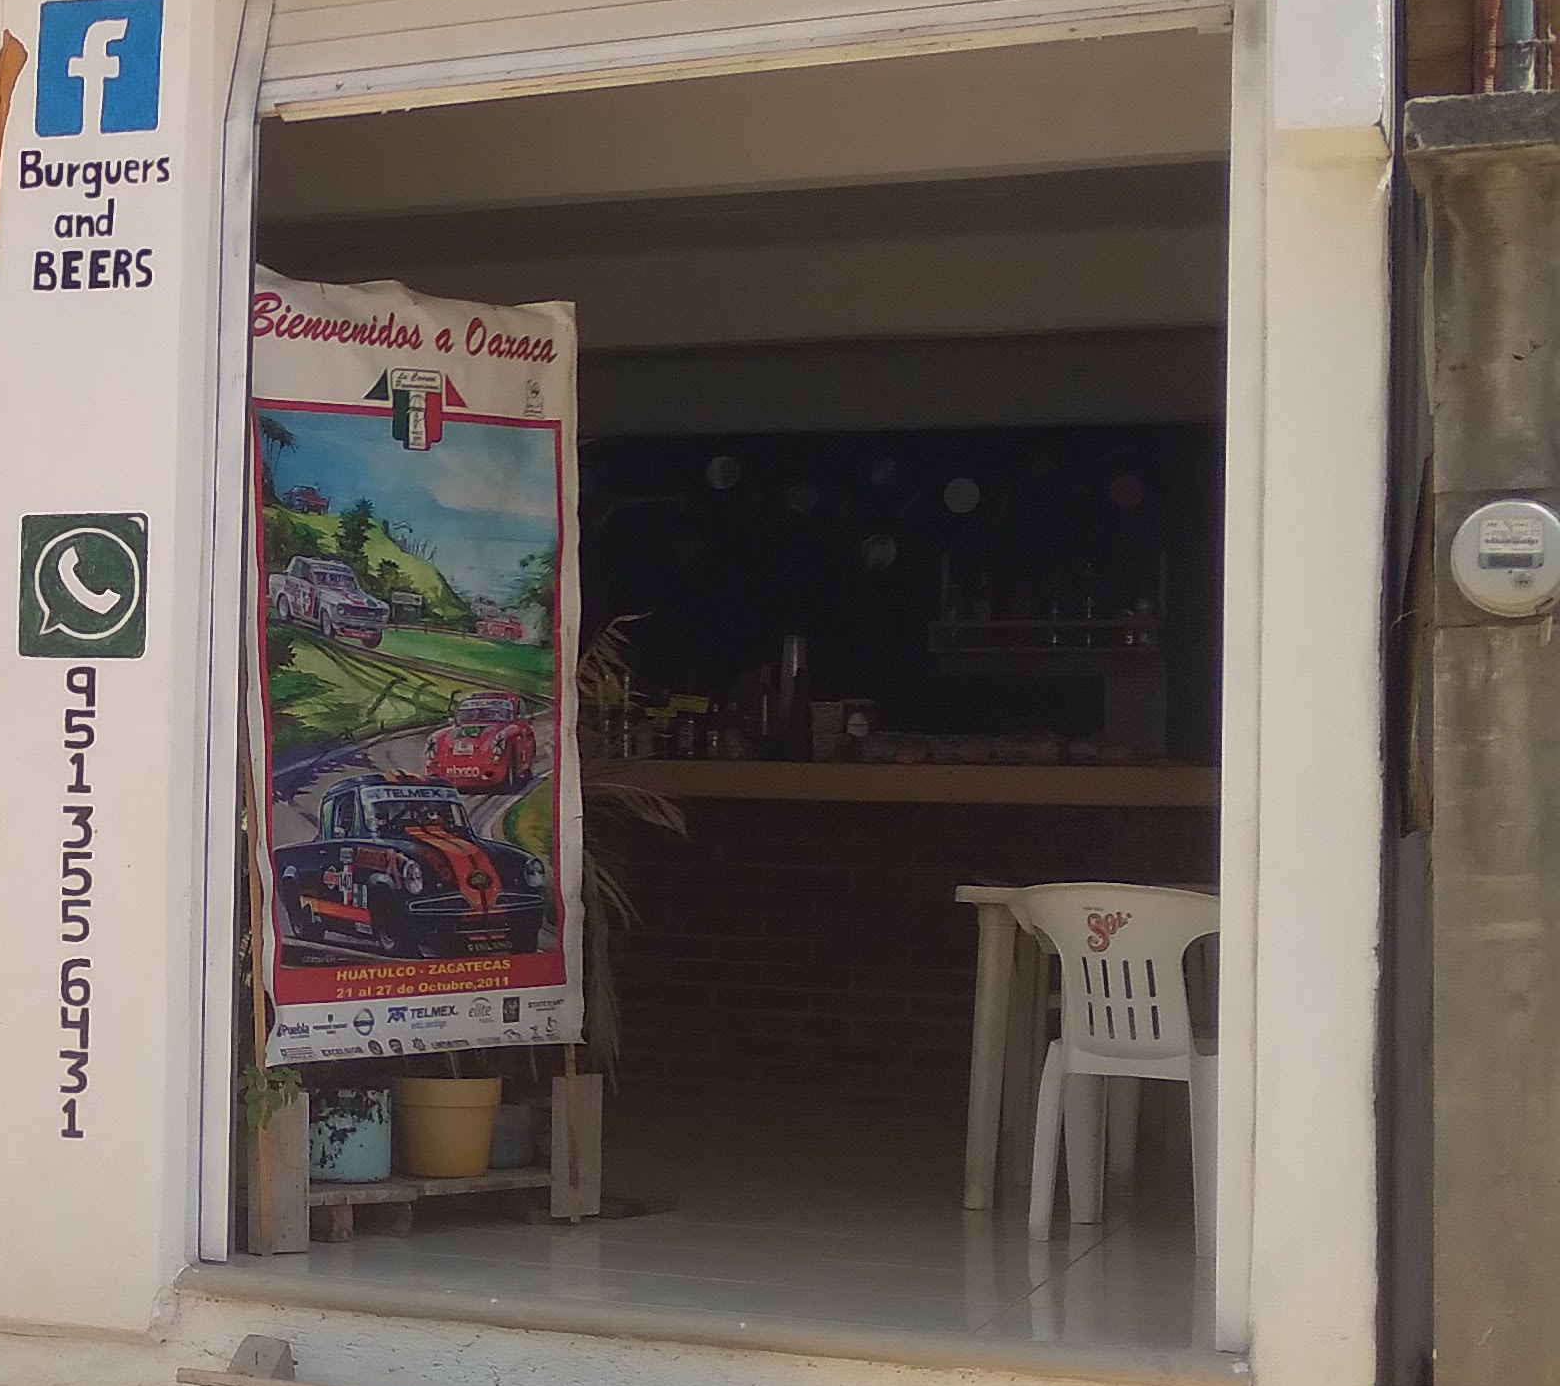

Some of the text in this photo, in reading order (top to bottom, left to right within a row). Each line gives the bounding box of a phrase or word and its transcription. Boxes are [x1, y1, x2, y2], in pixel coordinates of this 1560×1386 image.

[19, 150, 170, 199] Burguers
[54, 198, 115, 238] and
[33, 248, 153, 291] BEERS
[251, 292, 559, 365] Bienvenidos a Oaxaca
[384, 788, 441, 799] TELMEX
[336, 965, 416, 982] HUATULCO
[428, 959, 511, 976] ZACATECAS
[336, 987, 353, 1000] 21
[358, 986, 372, 998] al
[376, 984, 391, 997] 27
[397, 982, 414, 995] de
